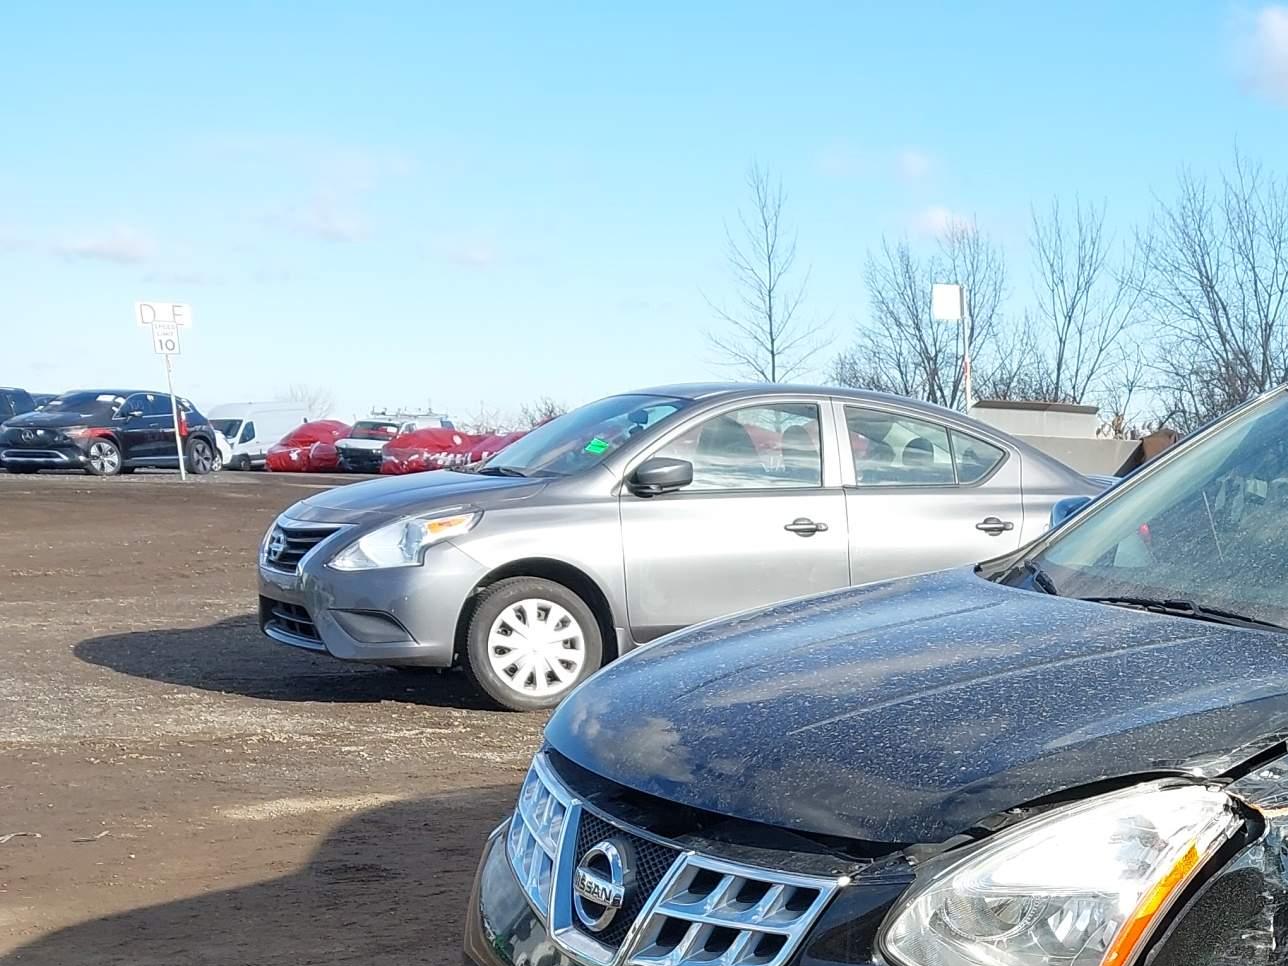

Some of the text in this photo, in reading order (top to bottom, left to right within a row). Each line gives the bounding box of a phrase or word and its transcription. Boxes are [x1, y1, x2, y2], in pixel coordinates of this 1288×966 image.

[140, 303, 184, 325] D E
[158, 339, 175, 351] 10
